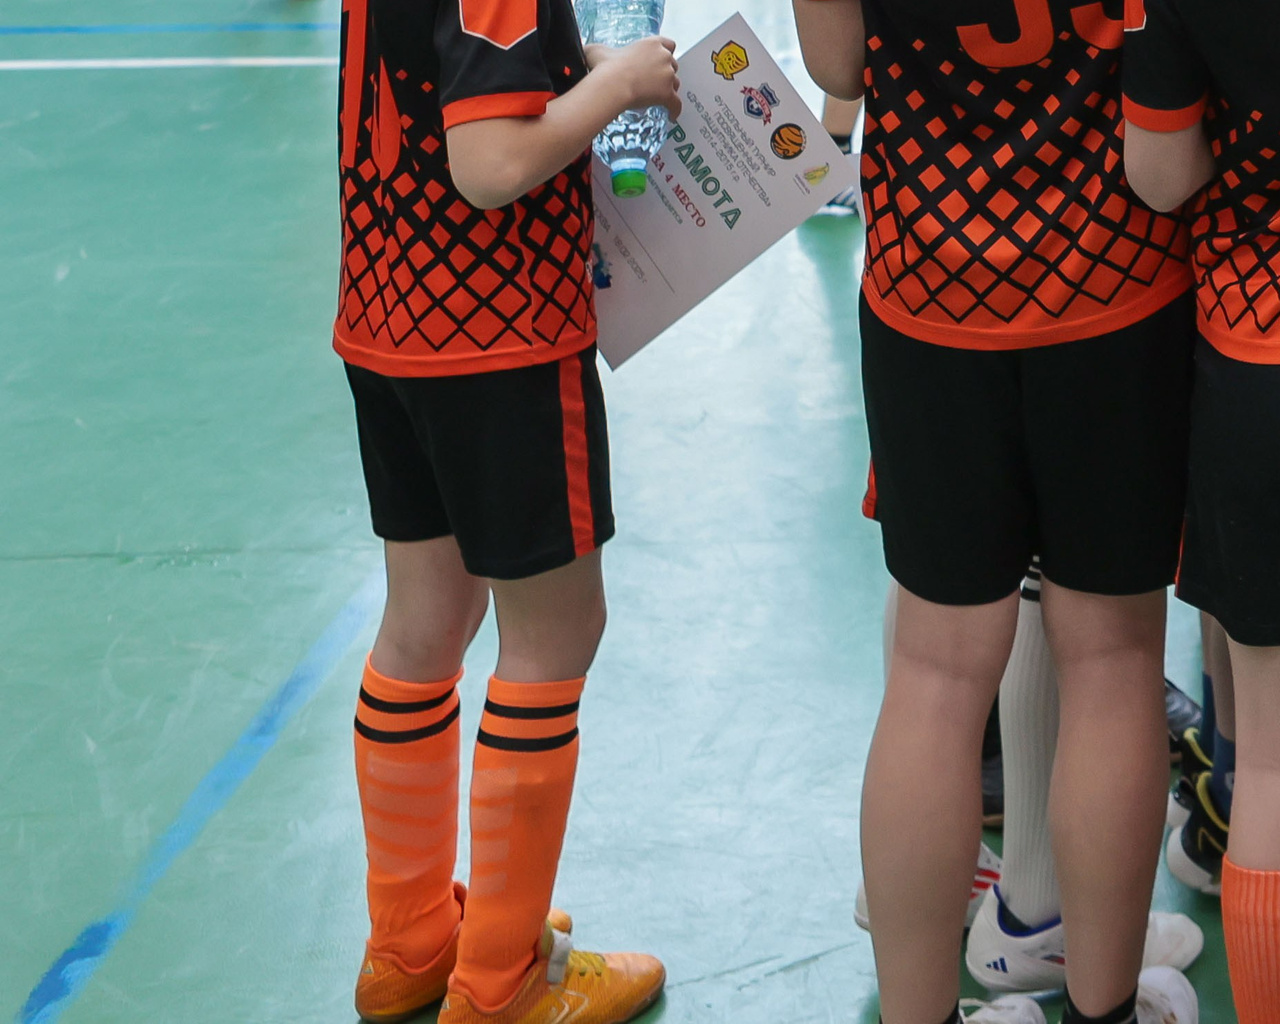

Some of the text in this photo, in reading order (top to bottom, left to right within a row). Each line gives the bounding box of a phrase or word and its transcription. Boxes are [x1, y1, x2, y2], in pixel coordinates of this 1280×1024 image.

[662, 121, 744, 229] РАМОТА
[701, 111, 738, 161] ЗАЩИТНИКА
[736, 160, 771, 206] ОТЕЧЕСТВА»
[713, 94, 754, 147] ФУТБОЛЬНЫЙ
[751, 146, 775, 177] ТУРНИР
[713, 112, 760, 172] ПОСВЯЩЕННЫЙ
[651, 154, 706, 228] ЗА 4 МЕСТО
